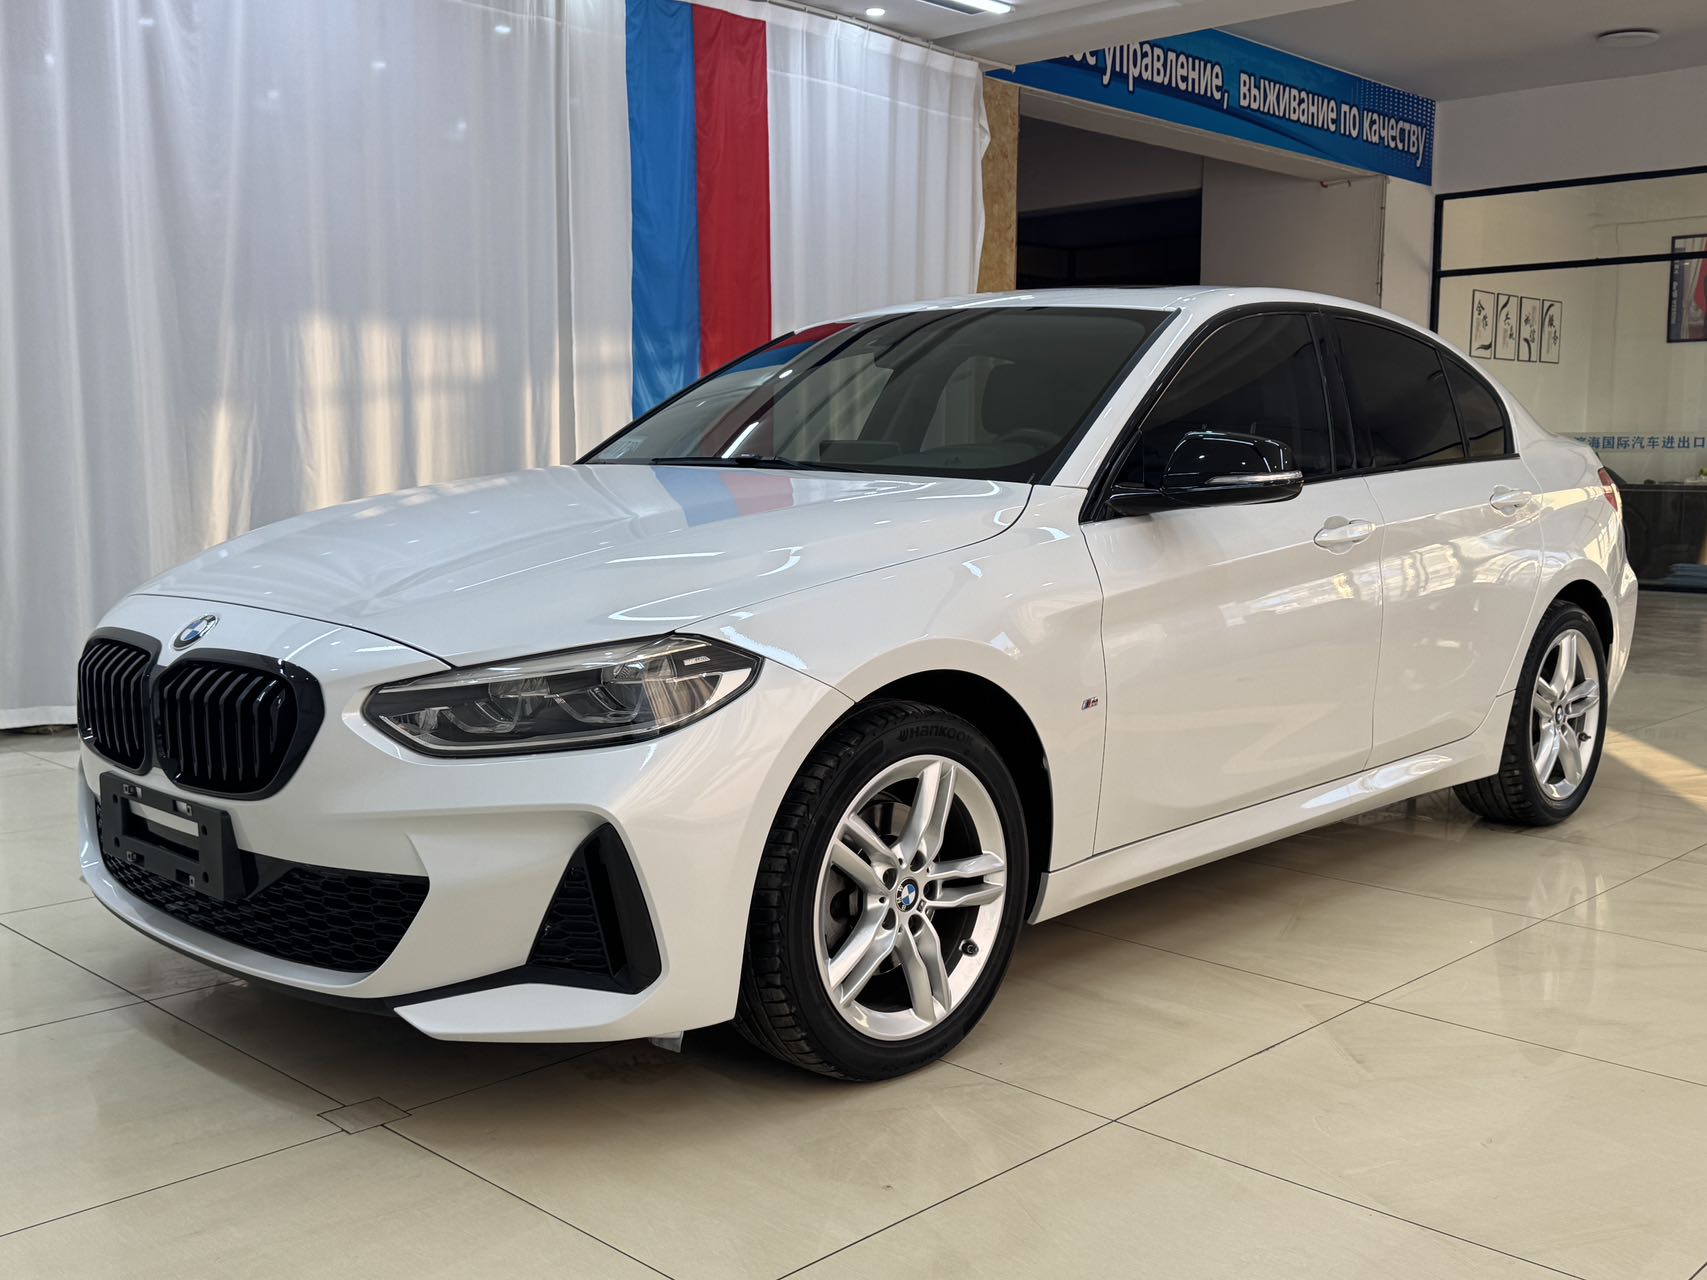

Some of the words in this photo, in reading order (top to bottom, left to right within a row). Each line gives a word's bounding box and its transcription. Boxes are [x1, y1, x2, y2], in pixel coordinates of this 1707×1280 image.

[1103, 43, 1229, 109] управление,
[1239, 73, 1337, 132] выживание
[1340, 103, 1360, 138] по
[1363, 110, 1427, 168] качеству
